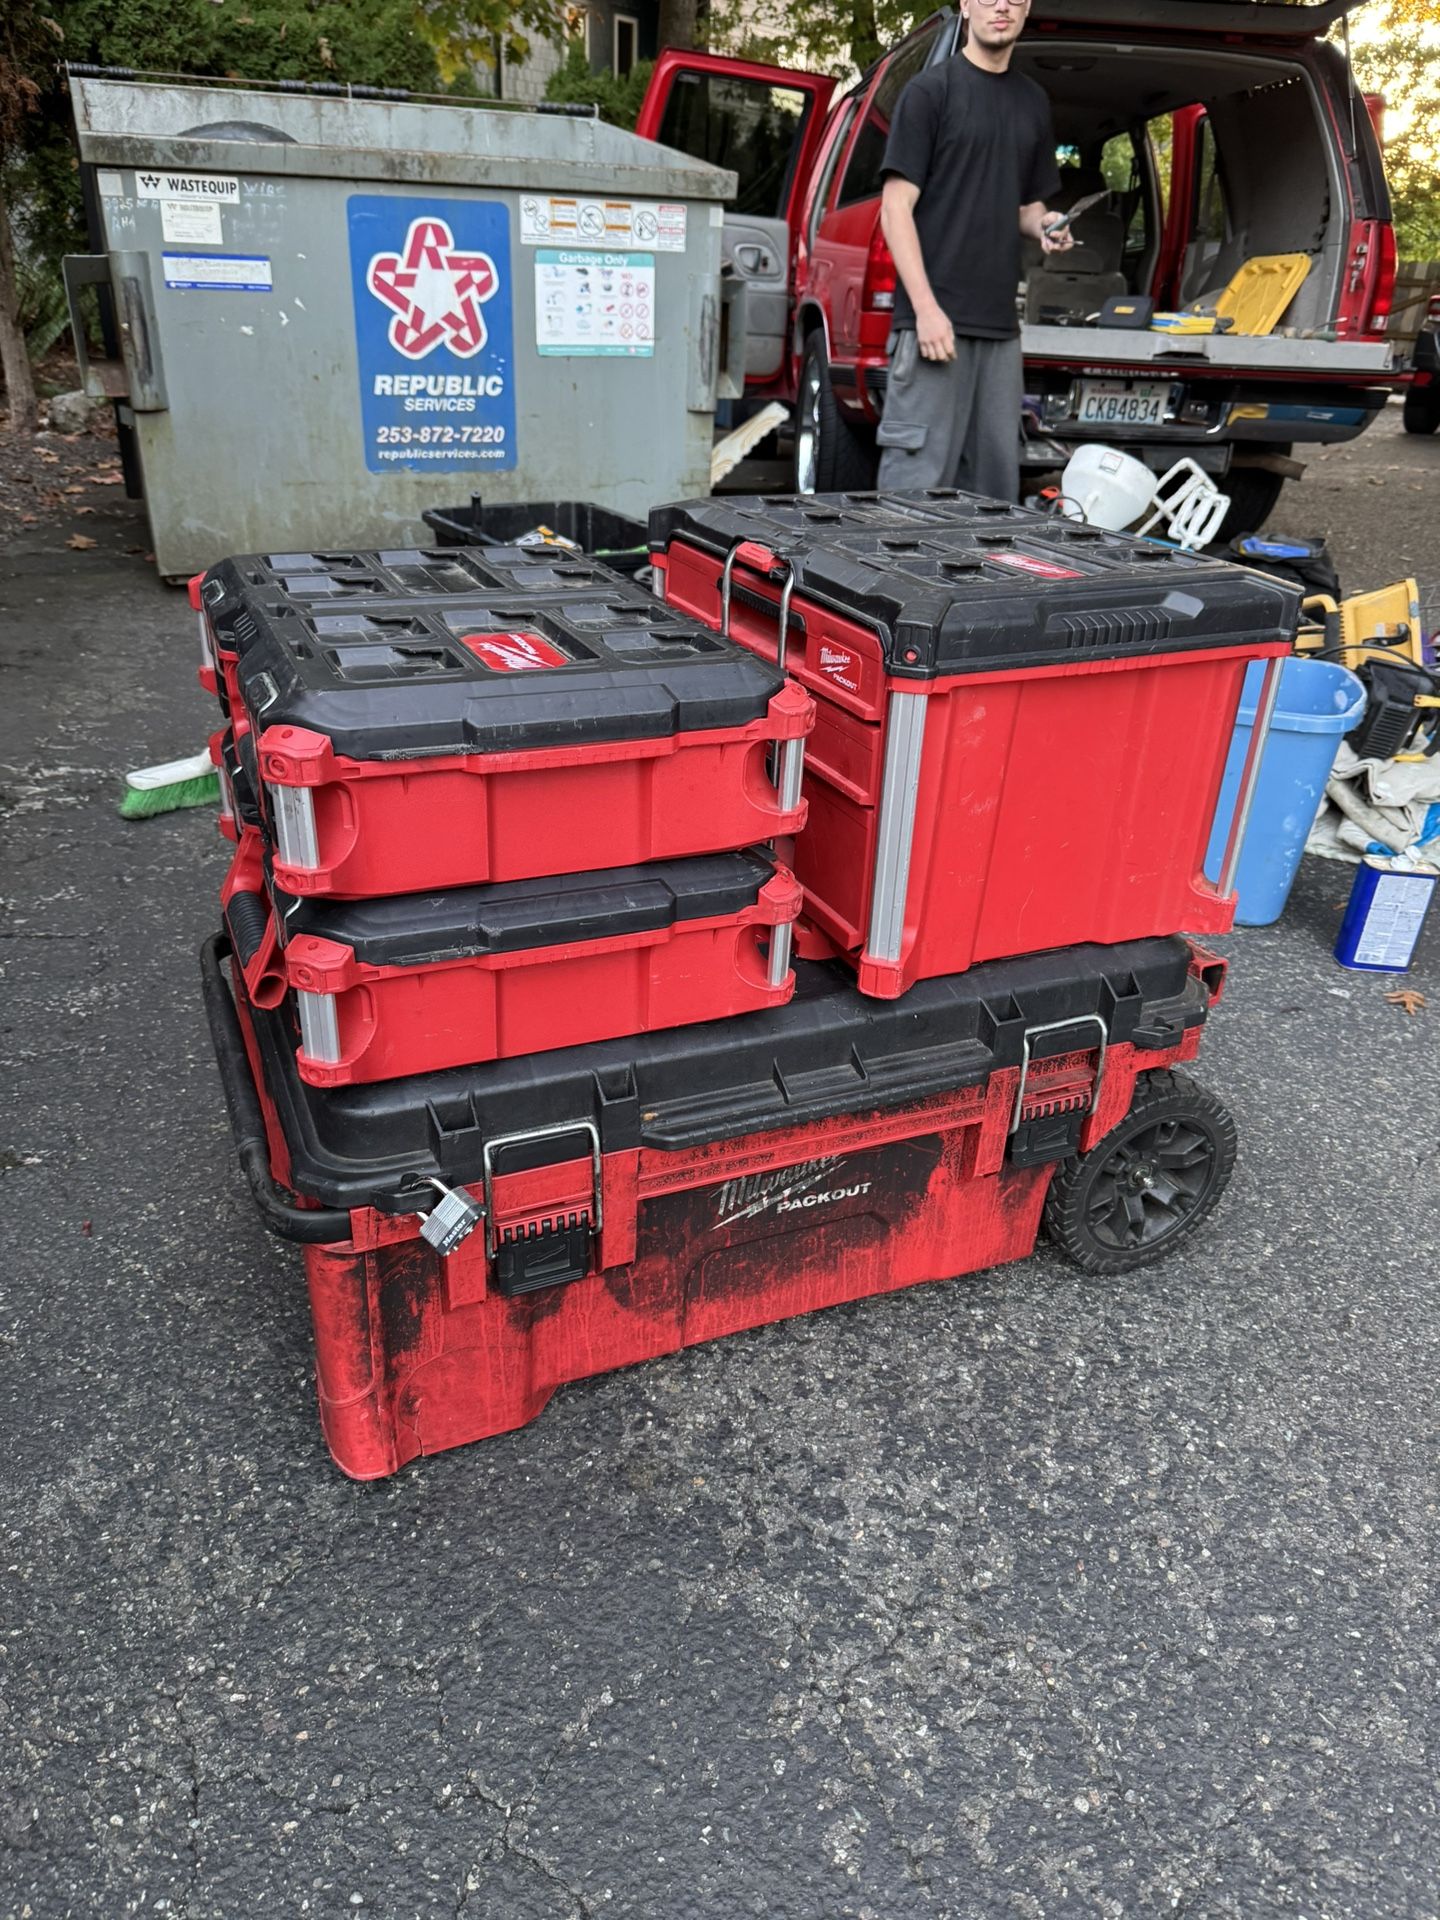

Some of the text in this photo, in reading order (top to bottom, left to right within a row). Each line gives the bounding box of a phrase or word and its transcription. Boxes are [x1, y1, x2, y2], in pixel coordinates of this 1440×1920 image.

[167, 177, 237, 195] WASTEQUIP
[559, 252, 629, 267] Garbage Only
[374, 375, 504, 397] REPUBLIC
[404, 398, 476, 412] SERVICES
[1085, 396, 1160, 421] CKB4834
[376, 425, 506, 444] 253-872-7220
[378, 449, 506, 462] republicservices.com
[820, 646, 851, 664] Milwaukee
[833, 673, 857, 691] PACKOUT
[776, 1182, 872, 1214] PACKOUT
[442, 1218, 467, 1247] Master
